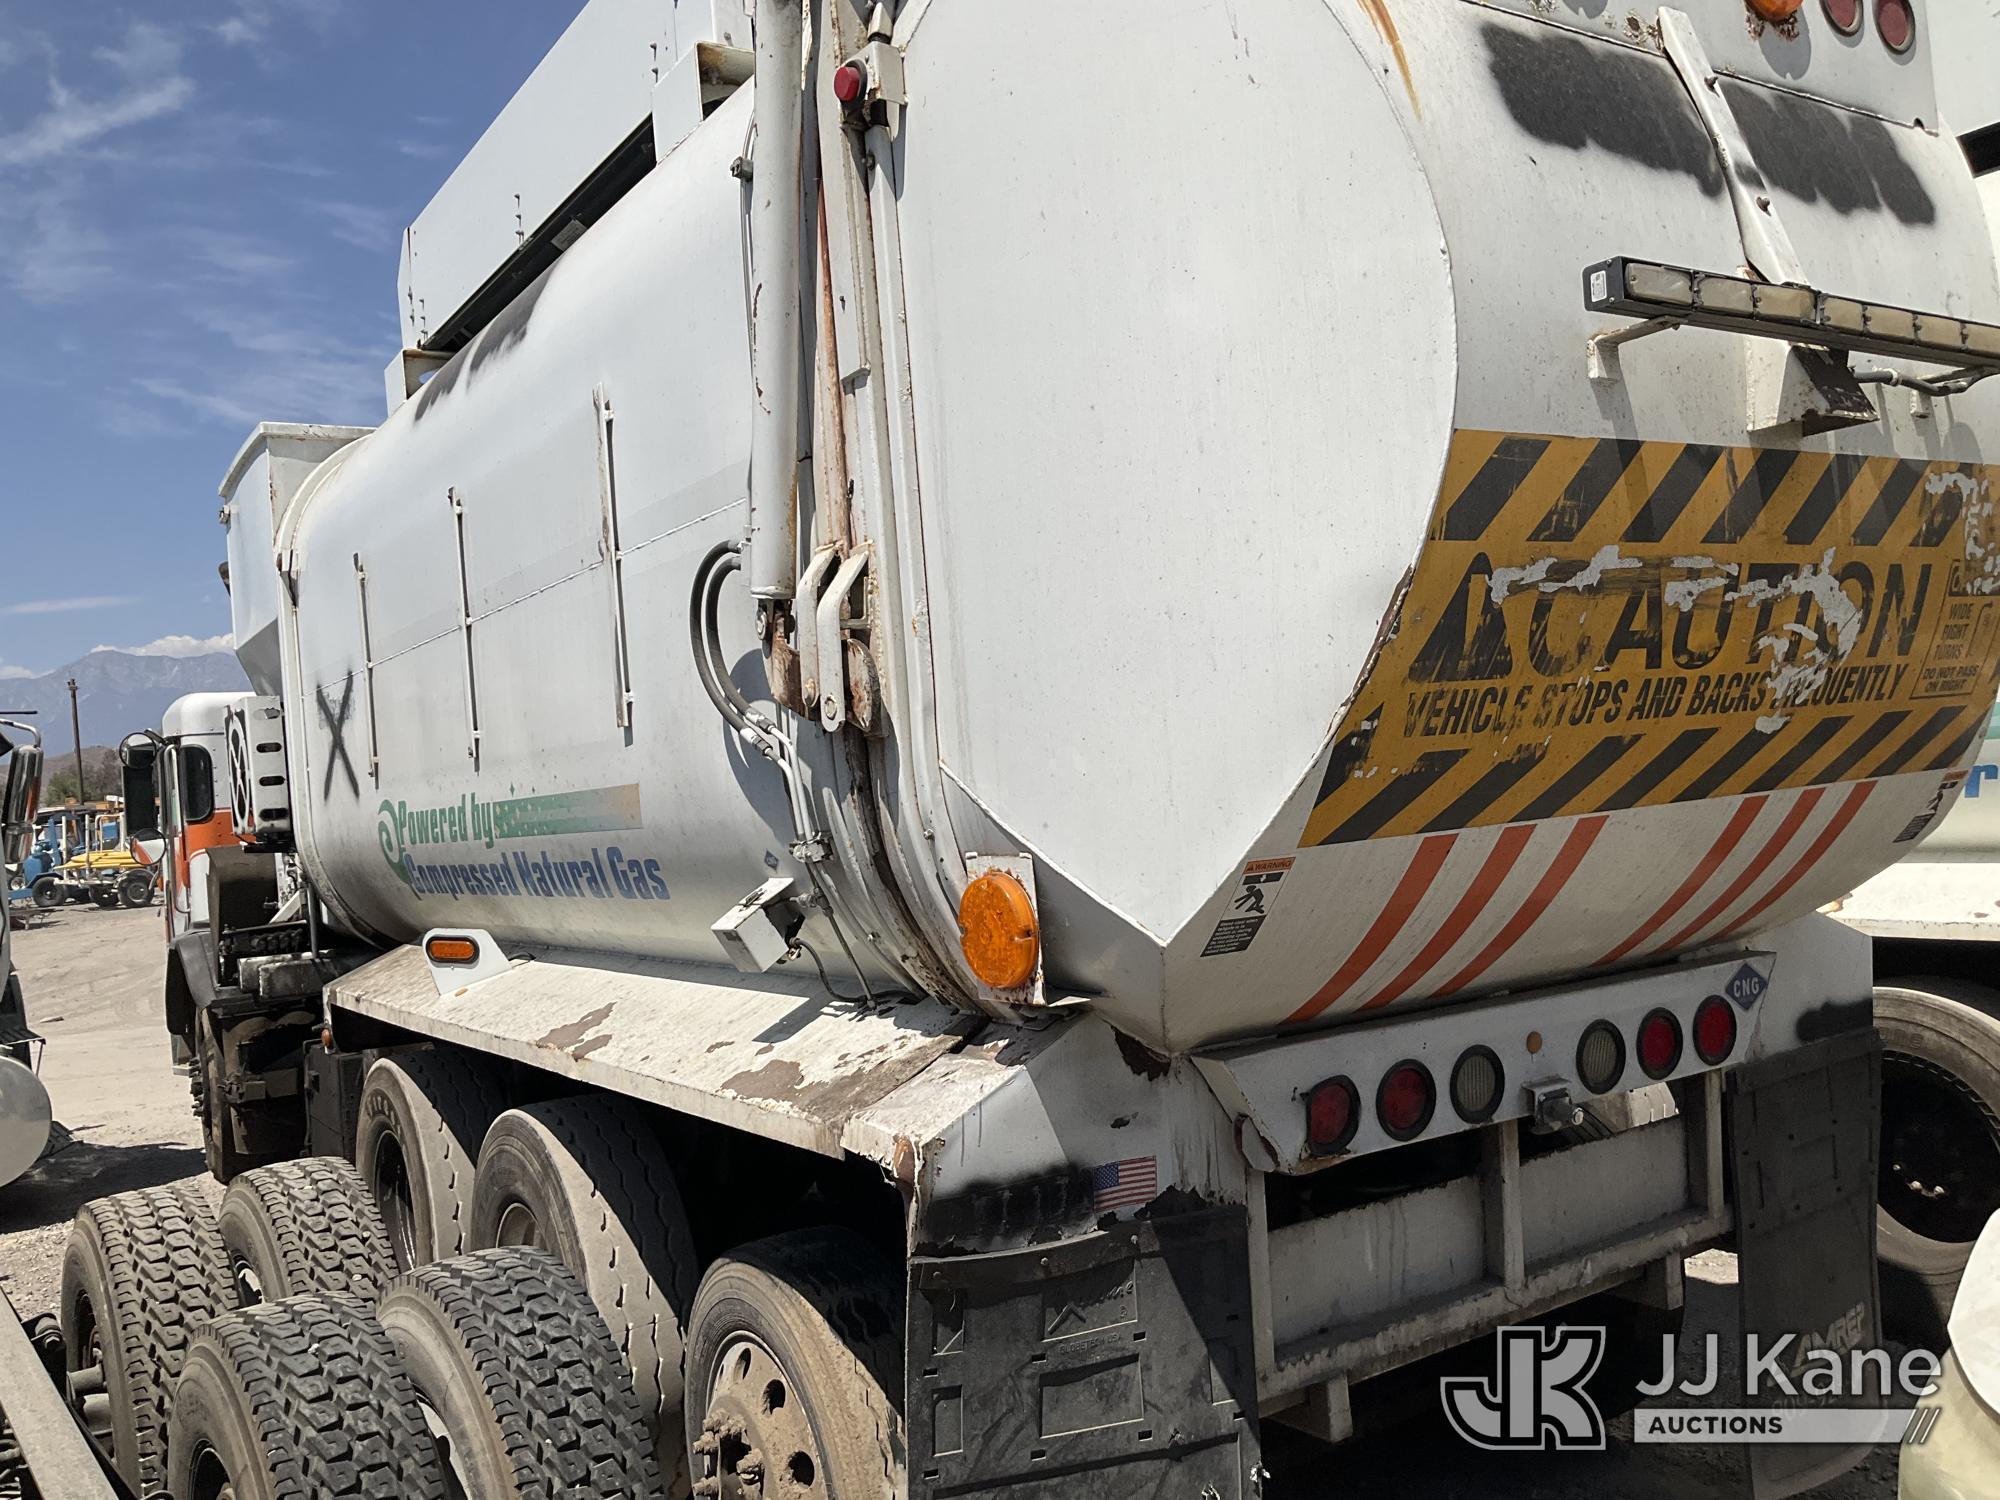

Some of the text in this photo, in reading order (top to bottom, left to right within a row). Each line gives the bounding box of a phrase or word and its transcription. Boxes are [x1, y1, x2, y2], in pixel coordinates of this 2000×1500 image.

[1626, 676, 1688, 720] AND
[1685, 671, 1772, 716] BACKS
[398, 792, 494, 849] Powered by
[404, 846, 671, 901] Compressed Natural Gas
[1255, 860, 1291, 871] WARNING
[1733, 976, 1760, 998] CNG
